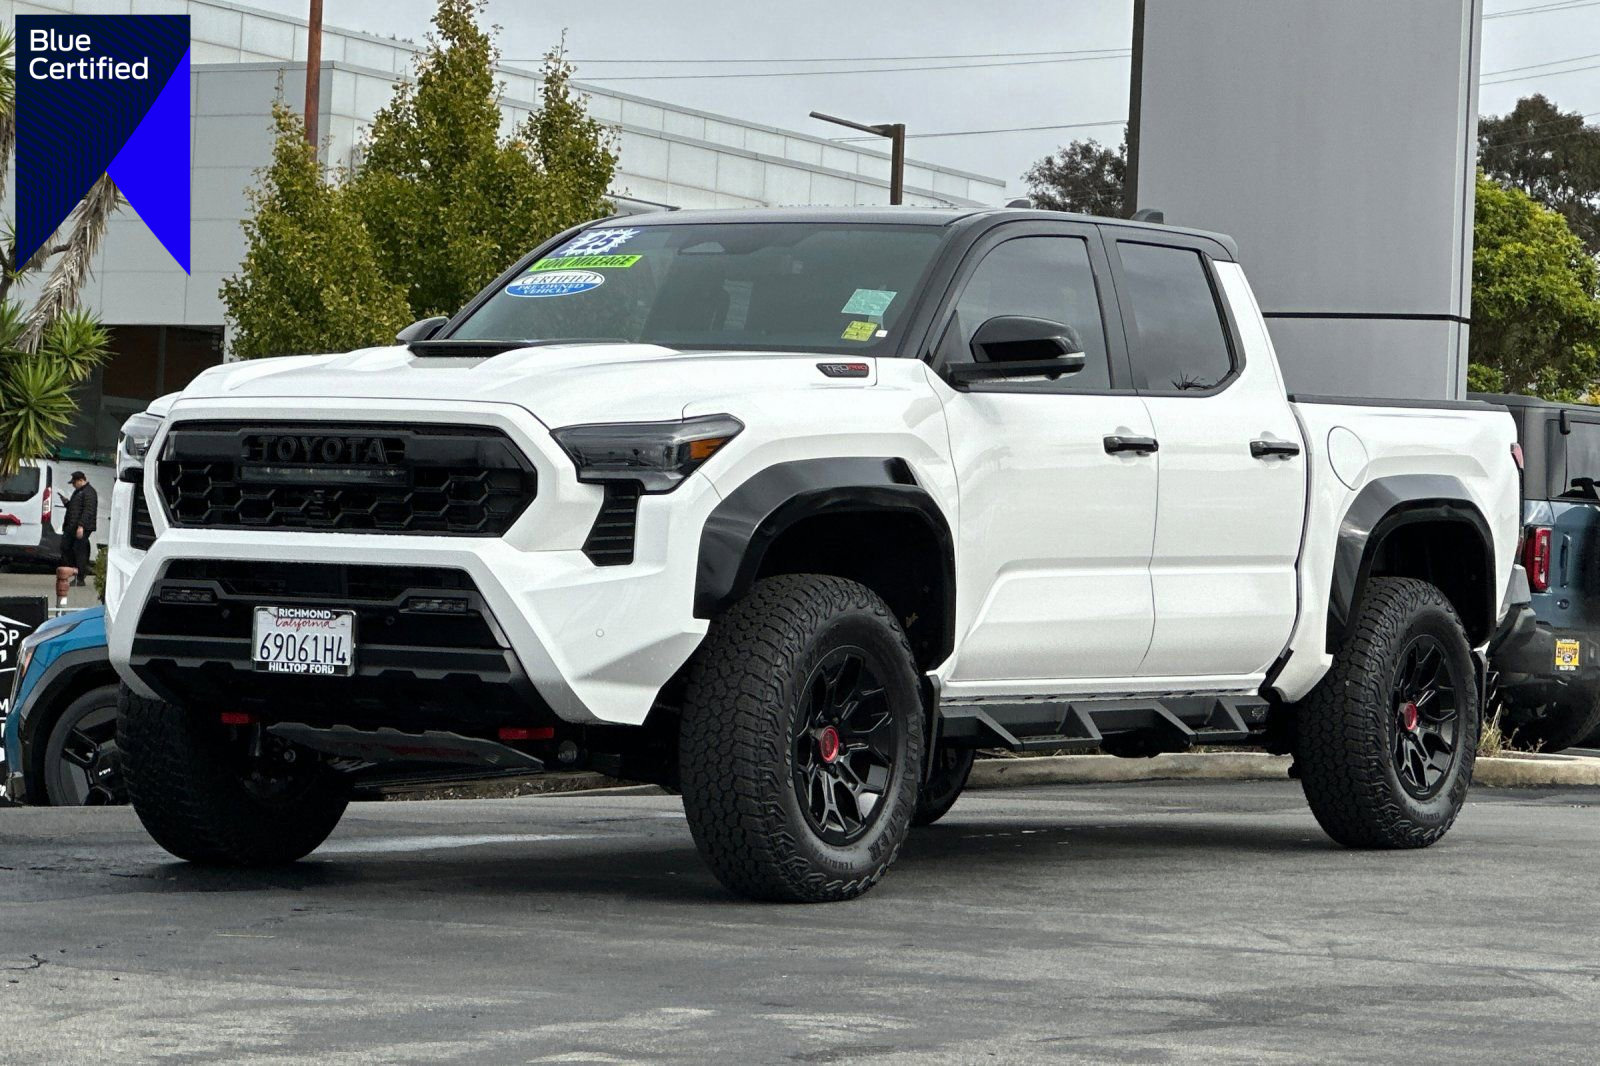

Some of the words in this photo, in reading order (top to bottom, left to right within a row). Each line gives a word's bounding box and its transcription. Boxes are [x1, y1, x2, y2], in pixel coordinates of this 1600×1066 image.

[537, 257, 574, 270] LOW
[568, 255, 634, 267] MILEAGE
[521, 274, 598, 285] CERTIFIED
[257, 434, 389, 463] TOYOTA
[278, 608, 331, 619] RICHMOND
[275, 618, 337, 632] California
[260, 632, 347, 664] 69061H4
[268, 661, 308, 673] HILLTOP
[309, 663, 335, 674] FORD
